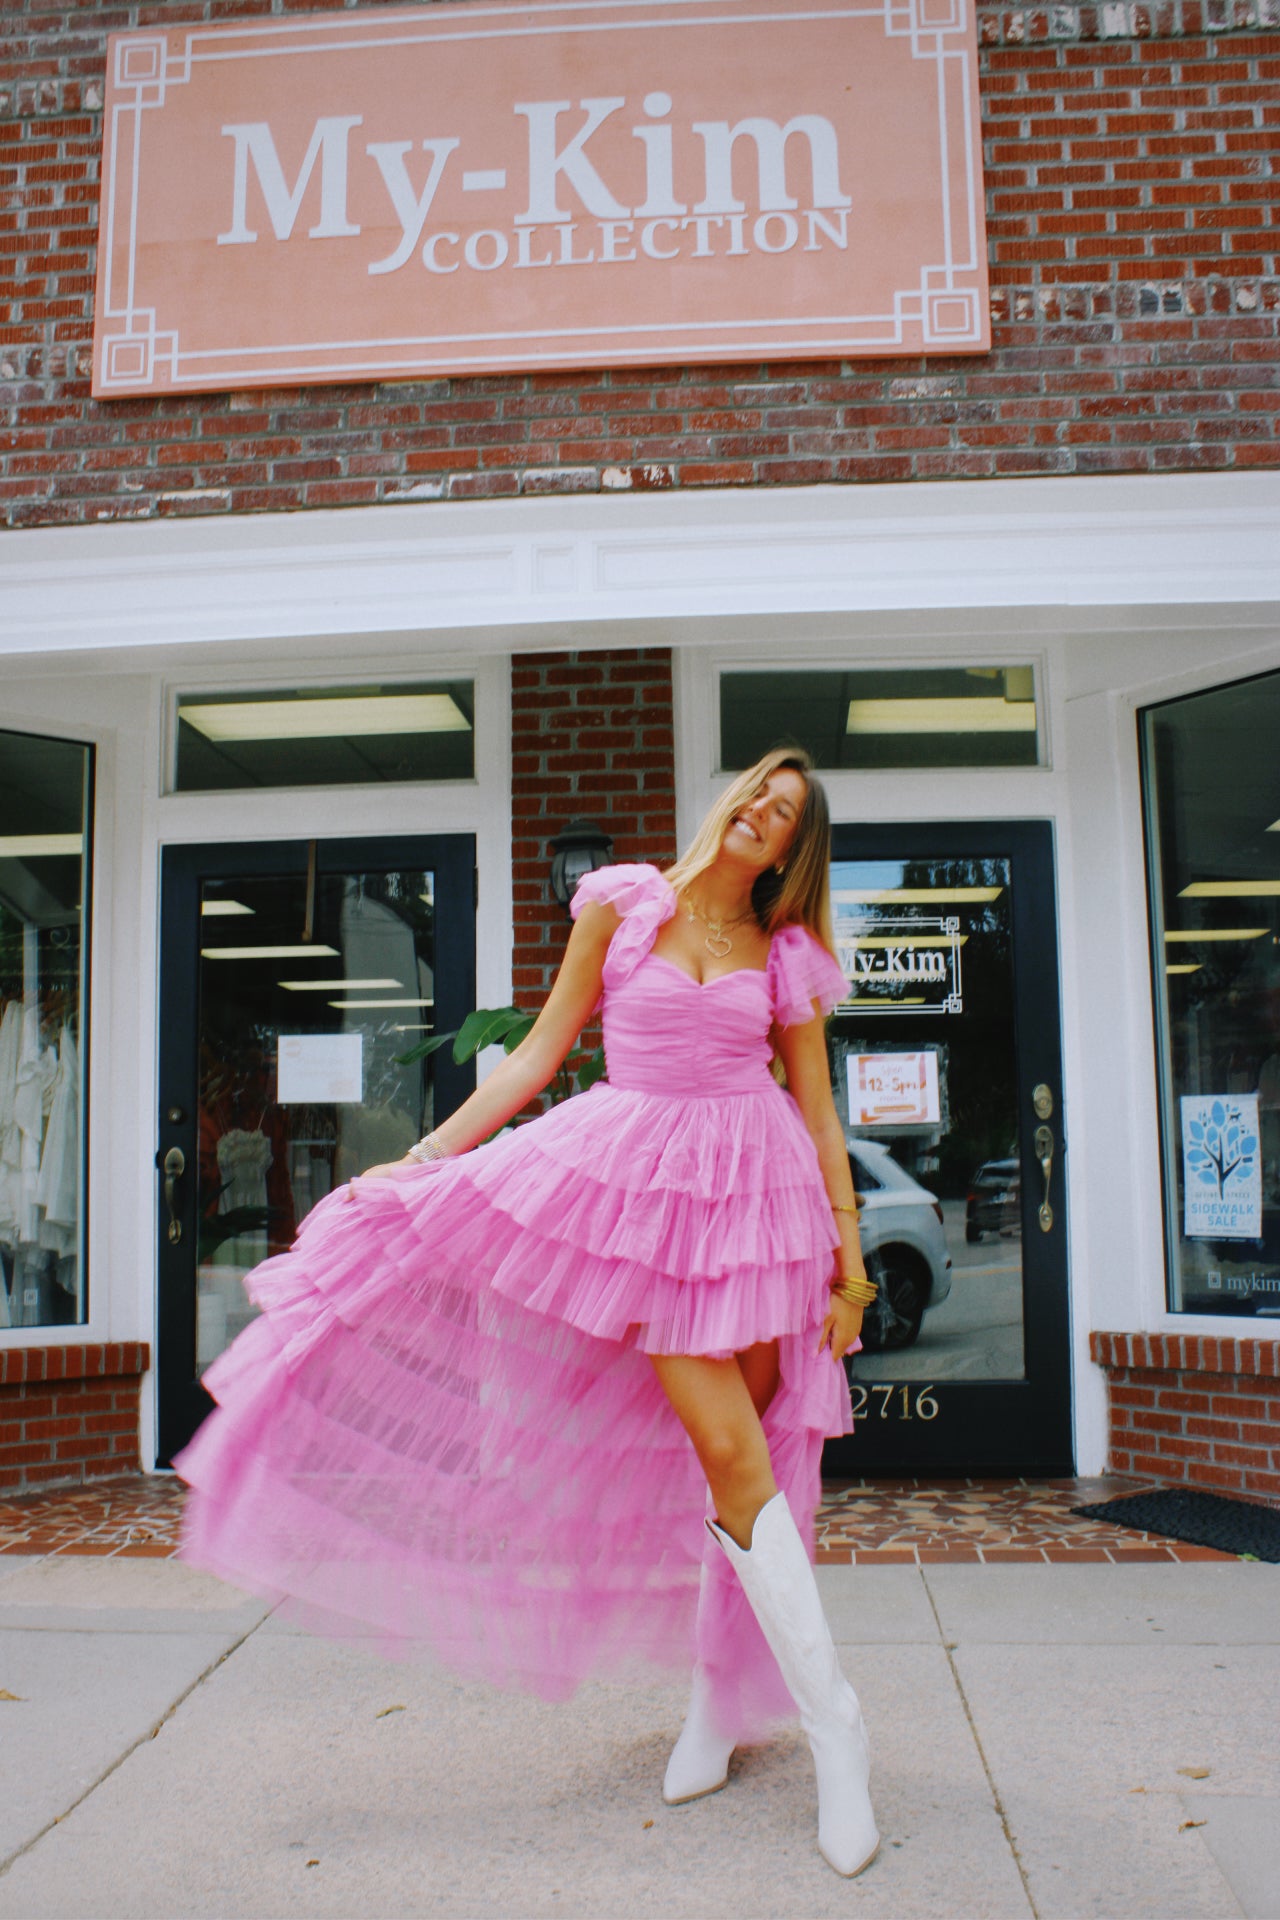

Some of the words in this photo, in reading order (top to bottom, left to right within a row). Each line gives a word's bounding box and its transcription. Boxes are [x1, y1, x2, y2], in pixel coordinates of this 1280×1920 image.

[216, 91, 852, 275] My-Kim
[422, 208, 852, 274] COLLECTION
[1191, 1203, 1255, 1215] SIDEWALK
[1207, 1215, 1238, 1227] SALE
[849, 1384, 940, 1420] 2716
